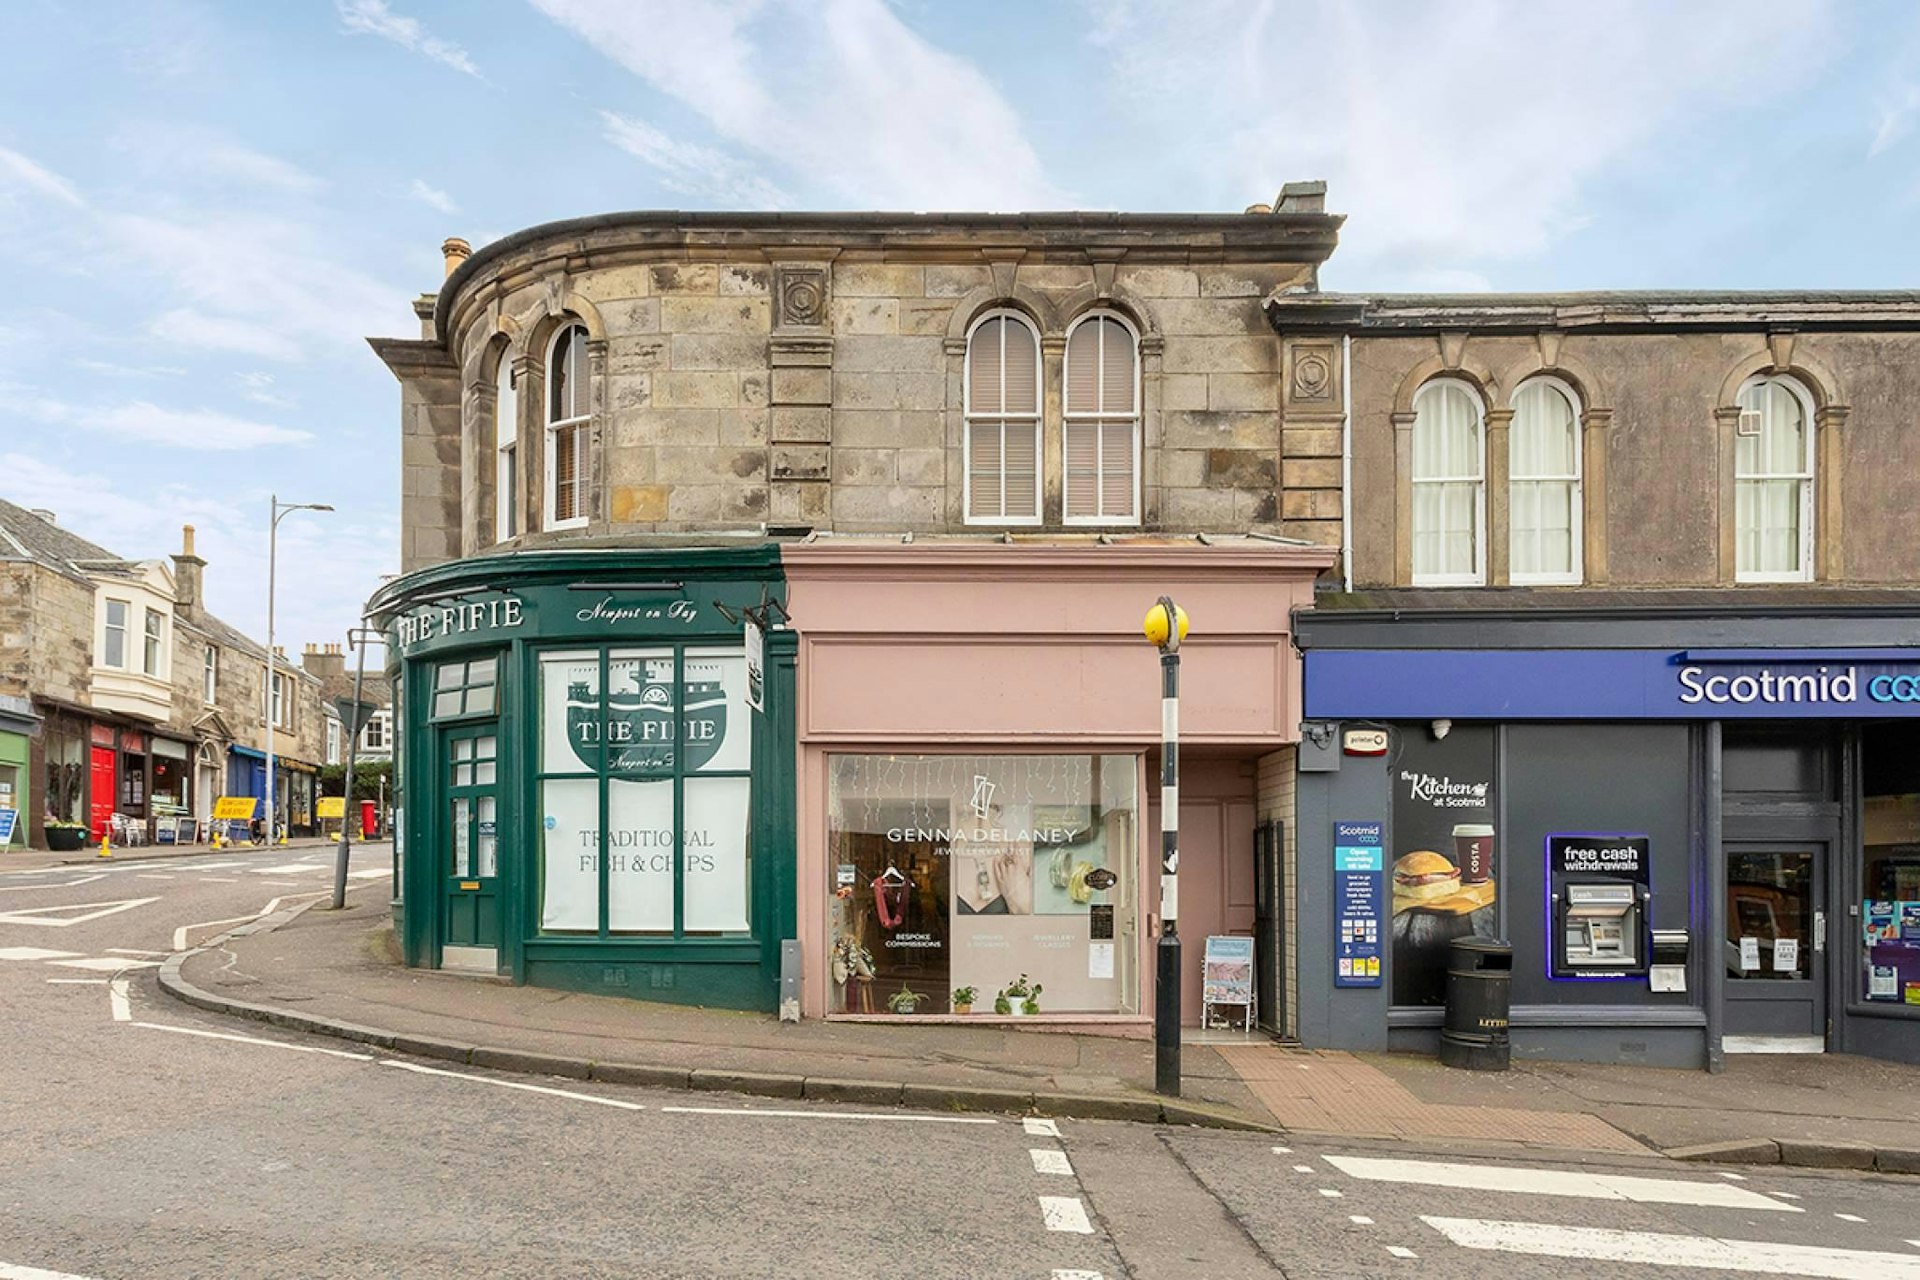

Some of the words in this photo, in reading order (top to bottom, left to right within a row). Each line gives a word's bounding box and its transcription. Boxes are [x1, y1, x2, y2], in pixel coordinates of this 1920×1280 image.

[576, 596, 640, 625] Newport
[645, 607, 661, 619] on
[667, 600, 698, 623] Tay
[397, 612, 436, 648] THE
[441, 598, 524, 636] FIFIE
[1680, 667, 1856, 702] Scotmid
[642, 719, 717, 741] FIIE
[1401, 770, 1415, 781] the
[1410, 773, 1473, 801] Kitchen
[1433, 797, 1444, 807] at
[1445, 797, 1486, 807] Scotmid
[887, 828, 967, 843] GENNA
[974, 828, 1078, 843] DELANEY
[1340, 825, 1379, 836] Scotmid
[1471, 842, 1480, 873] COSTA
[1564, 846, 1598, 860] free
[1600, 846, 1638, 860] cash
[631, 854, 646, 873] &
[1564, 860, 1639, 871] withdrawals
[885, 940, 941, 948] COMMISSIONS
[896, 933, 931, 941] BESPOKE
